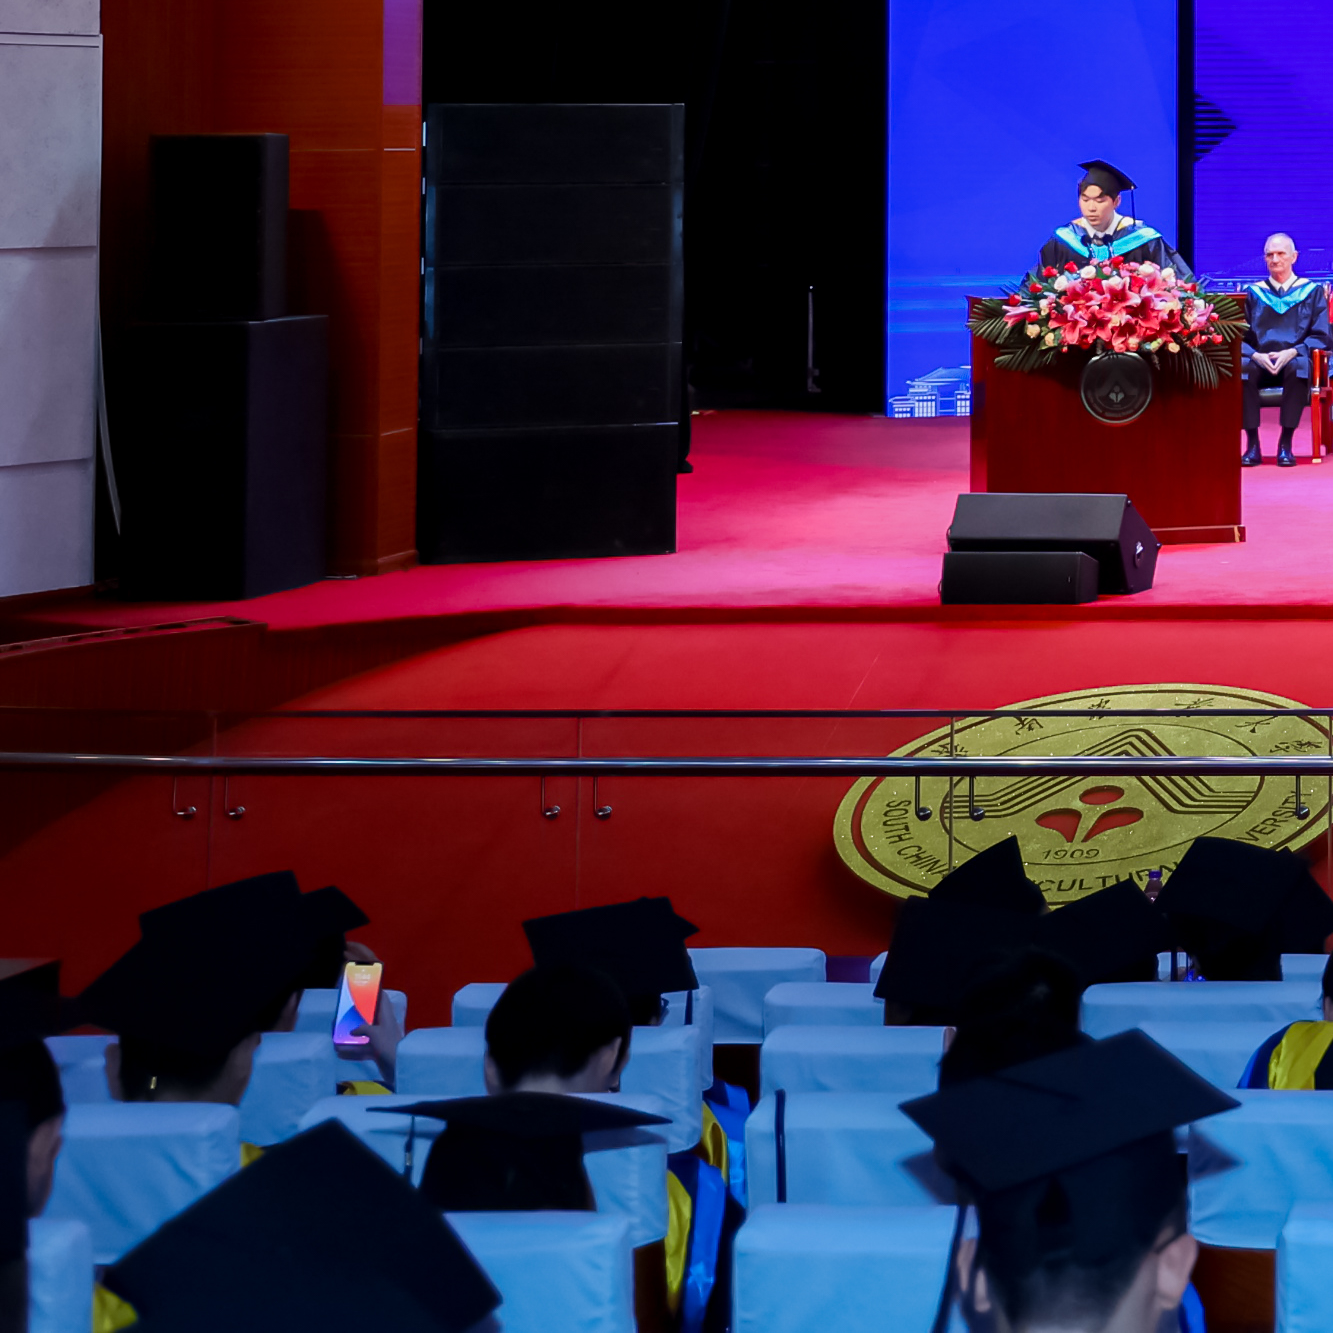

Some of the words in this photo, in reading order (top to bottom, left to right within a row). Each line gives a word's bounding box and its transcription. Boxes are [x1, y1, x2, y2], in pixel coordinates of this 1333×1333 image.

[883, 800, 914, 845] SOUTH
[1236, 790, 1312, 842] VERSITY
[1043, 848, 1100, 860] 1909
